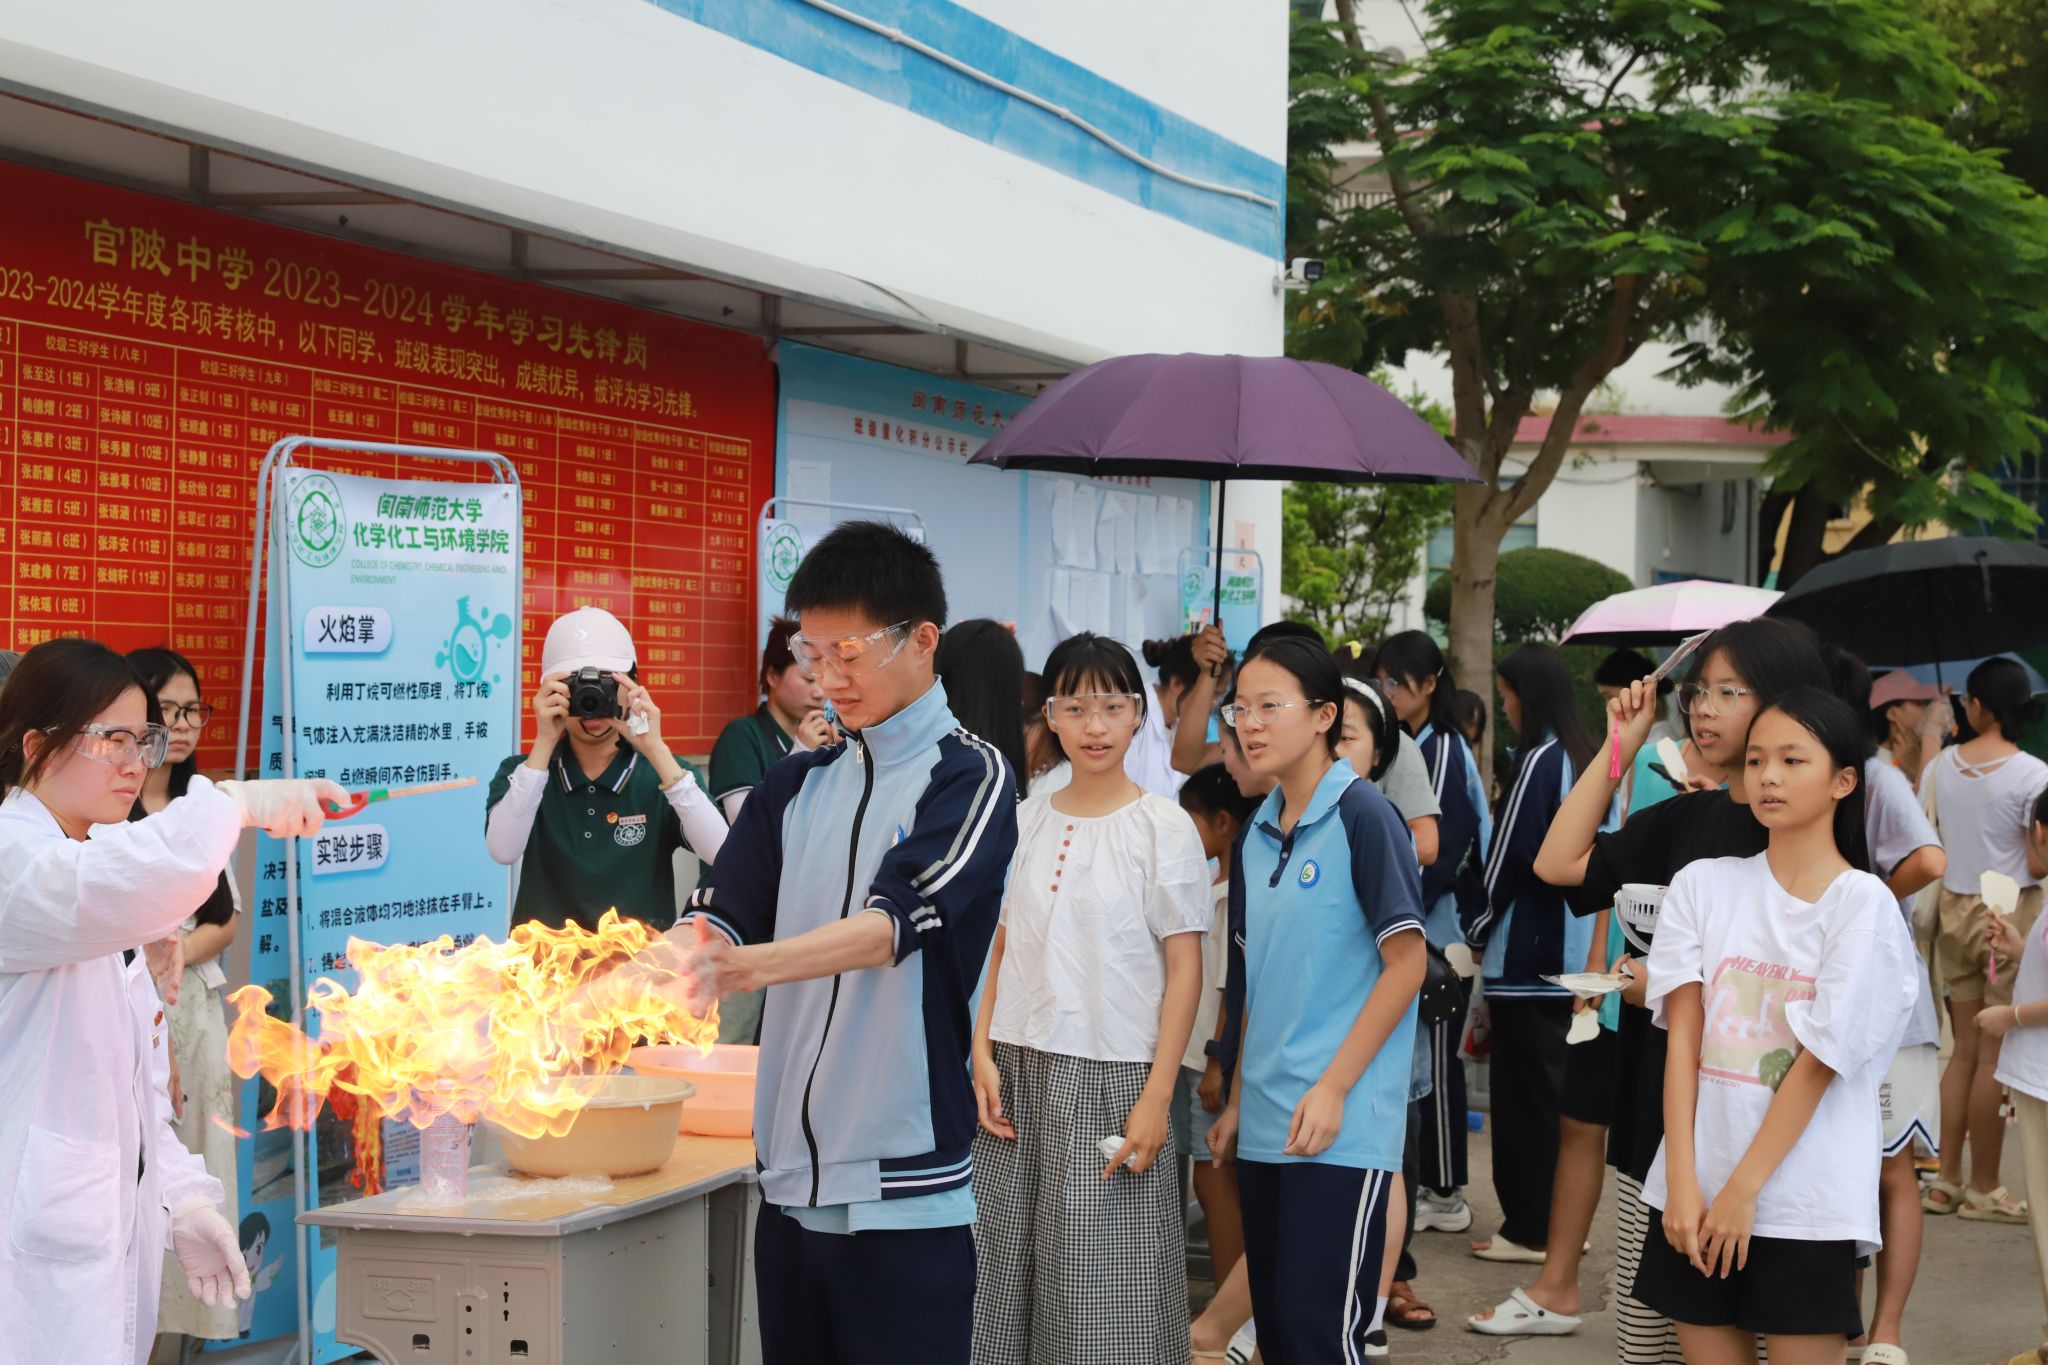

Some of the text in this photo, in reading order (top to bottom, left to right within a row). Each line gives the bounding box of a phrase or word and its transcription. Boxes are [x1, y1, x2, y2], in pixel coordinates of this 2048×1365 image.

[85, 217, 648, 370] 官陂中学 2023-2024 学年学习先锋岗
[377, 492, 483, 523] 闽南师范大学
[353, 522, 509, 554] 化学化工与环境学院
[318, 614, 375, 644] 火焰掌
[326, 681, 489, 702] 利用丁烷可燃性原理，将丁烷
[303, 721, 488, 746] 气体注入充满洗洁精的水里，手被
[316, 833, 384, 866] 实验步骤
[1730, 955, 1802, 982] HEAVENLY
